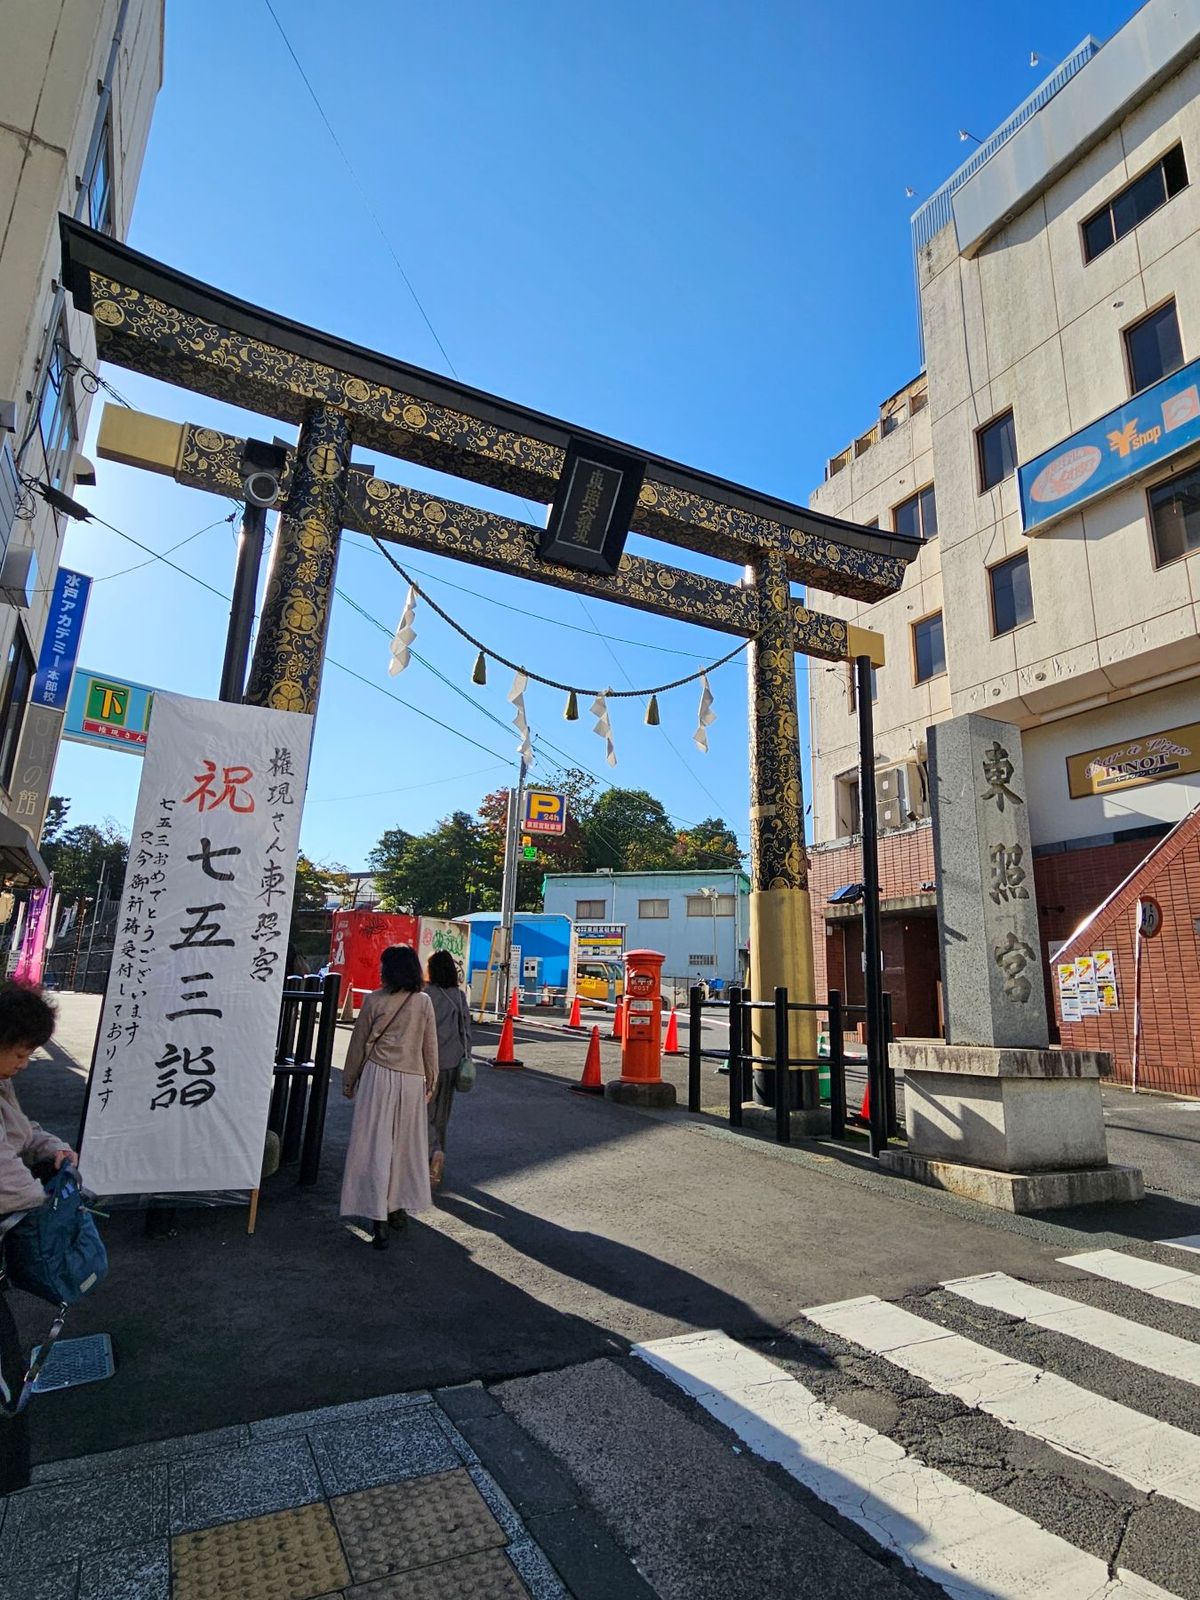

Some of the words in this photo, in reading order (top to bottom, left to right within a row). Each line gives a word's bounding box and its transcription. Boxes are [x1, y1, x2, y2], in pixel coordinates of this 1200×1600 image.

[1104, 752, 1170, 778] PINOT
[530, 793, 561, 819] P
[543, 814, 560, 822] 24h
[980, 741, 1037, 1004] 東照宮
[125, 797, 176, 1047] 七五三おめでとうございます
